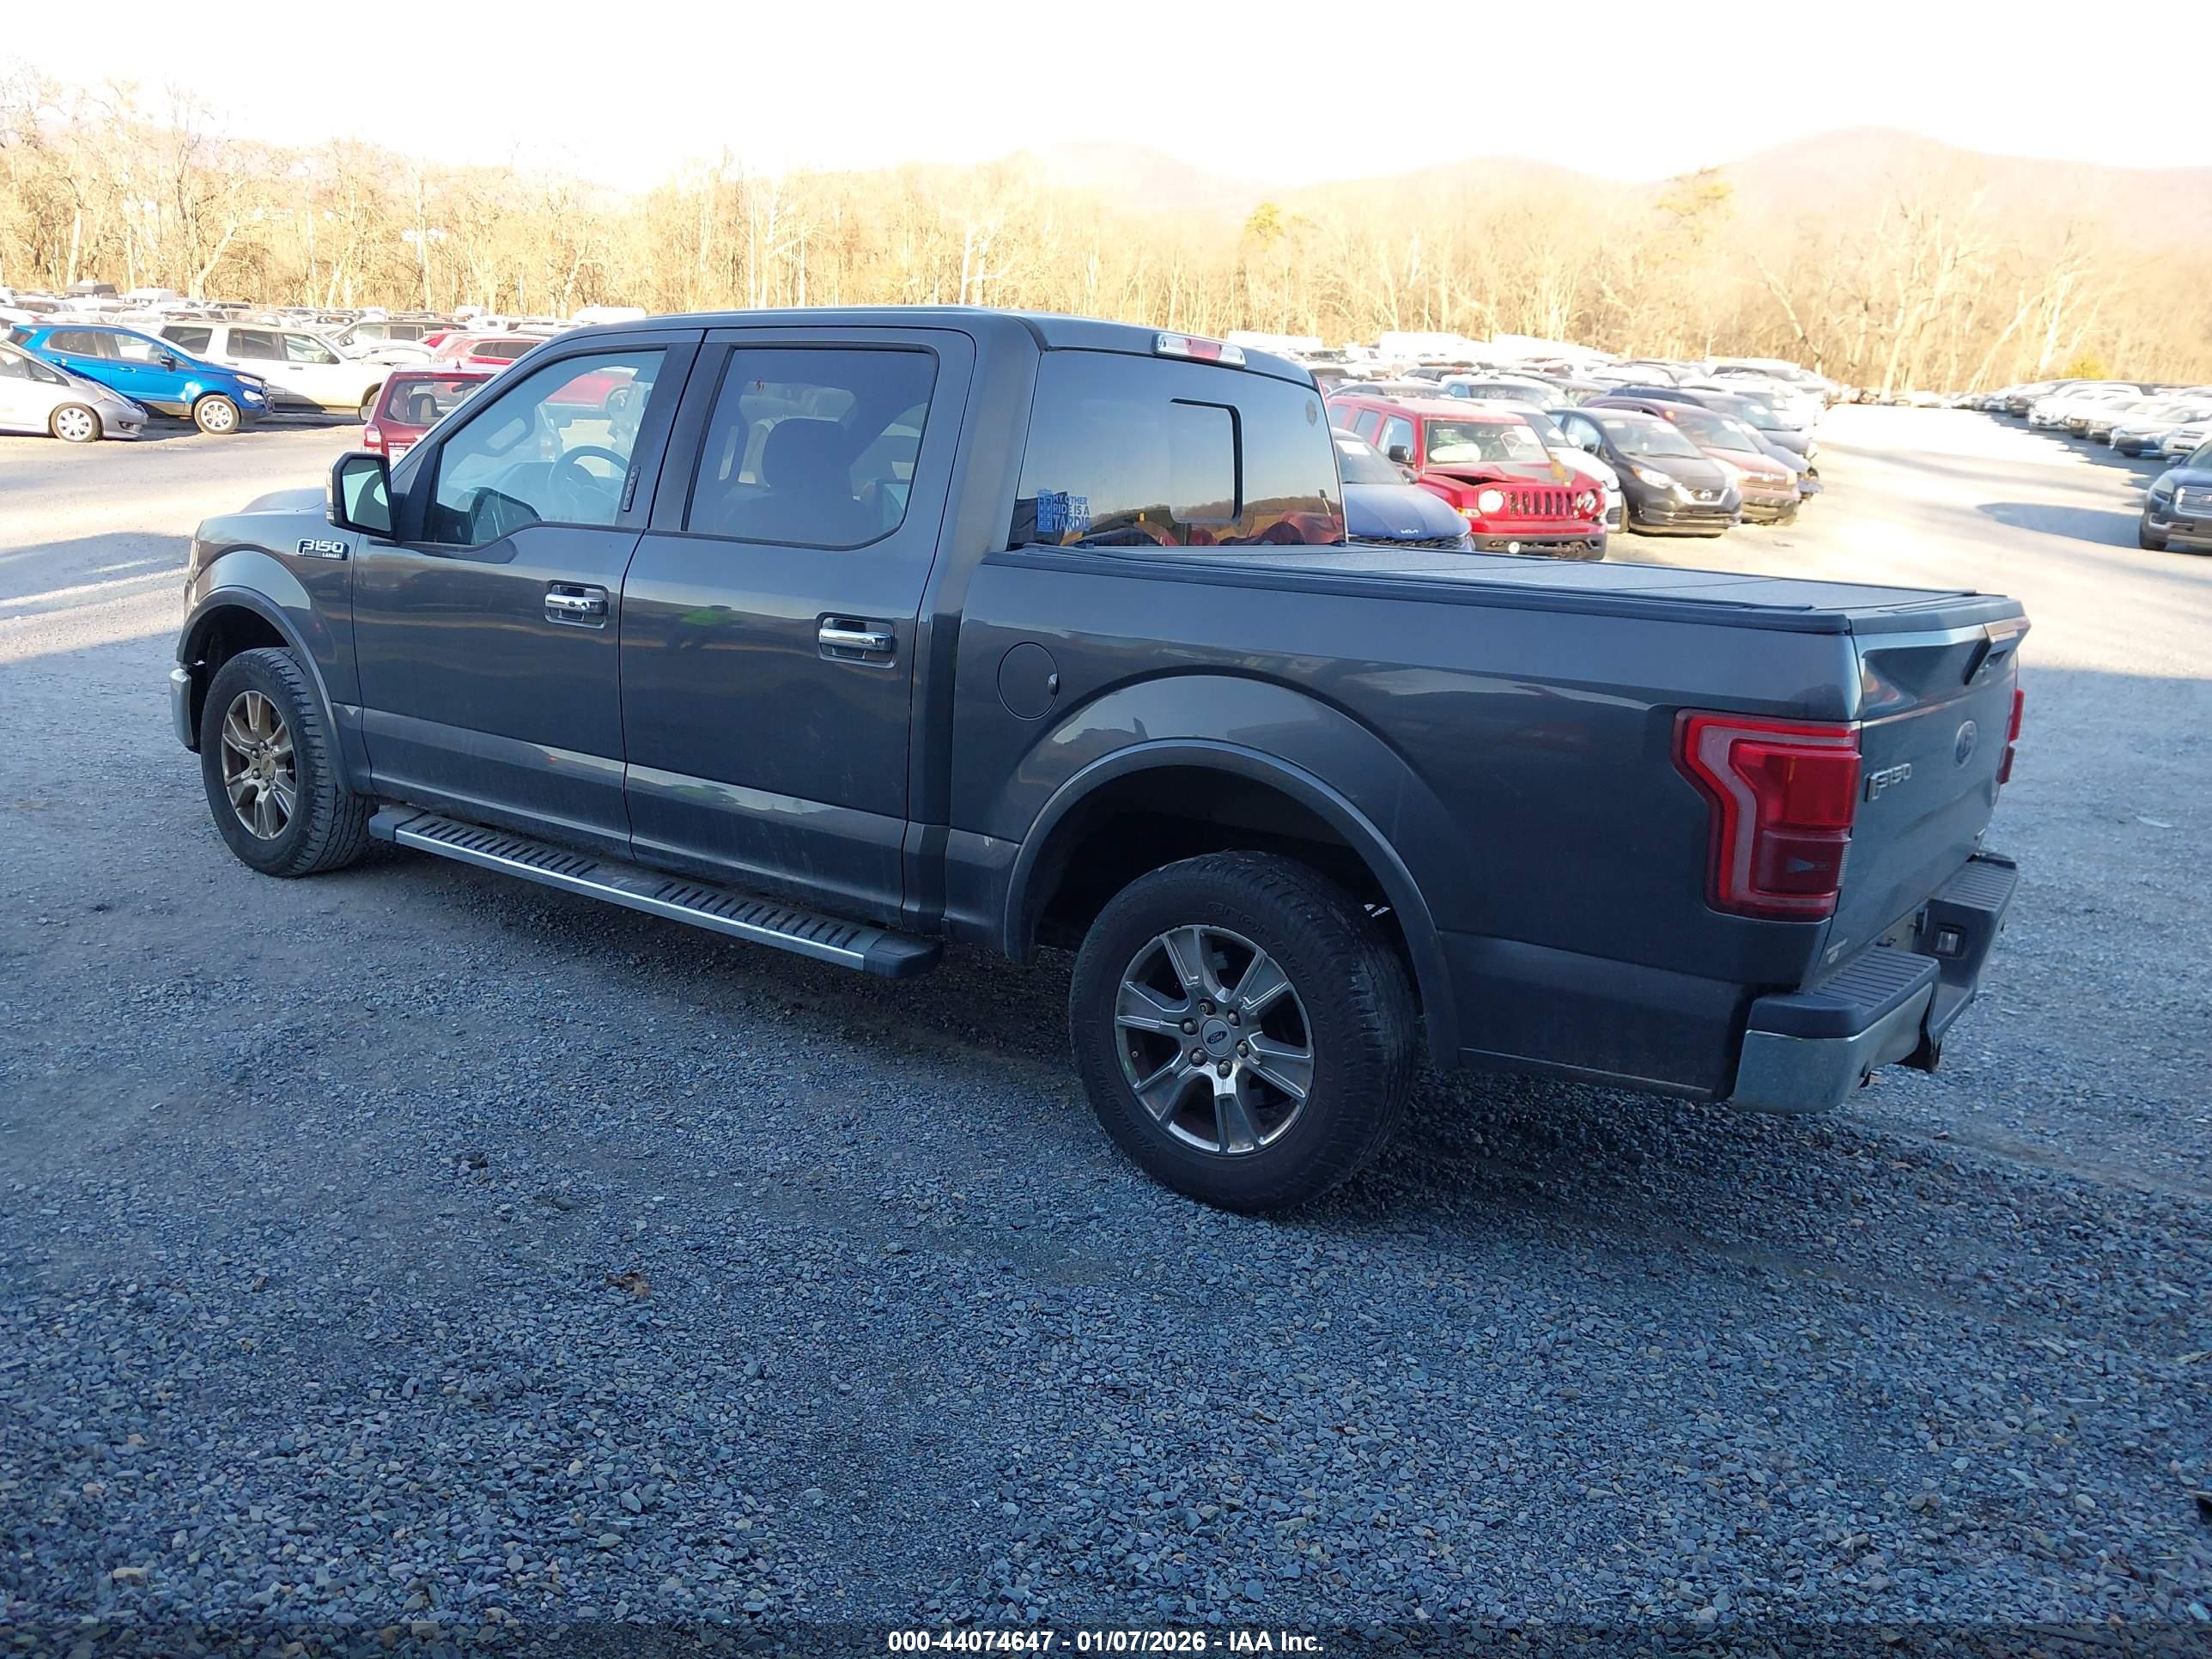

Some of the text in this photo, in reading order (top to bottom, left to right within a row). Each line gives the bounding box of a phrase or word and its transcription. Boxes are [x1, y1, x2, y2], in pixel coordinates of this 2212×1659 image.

[1053, 495, 1088, 505] MY OTHER
[1053, 504, 1091, 516] RIDE IS A
